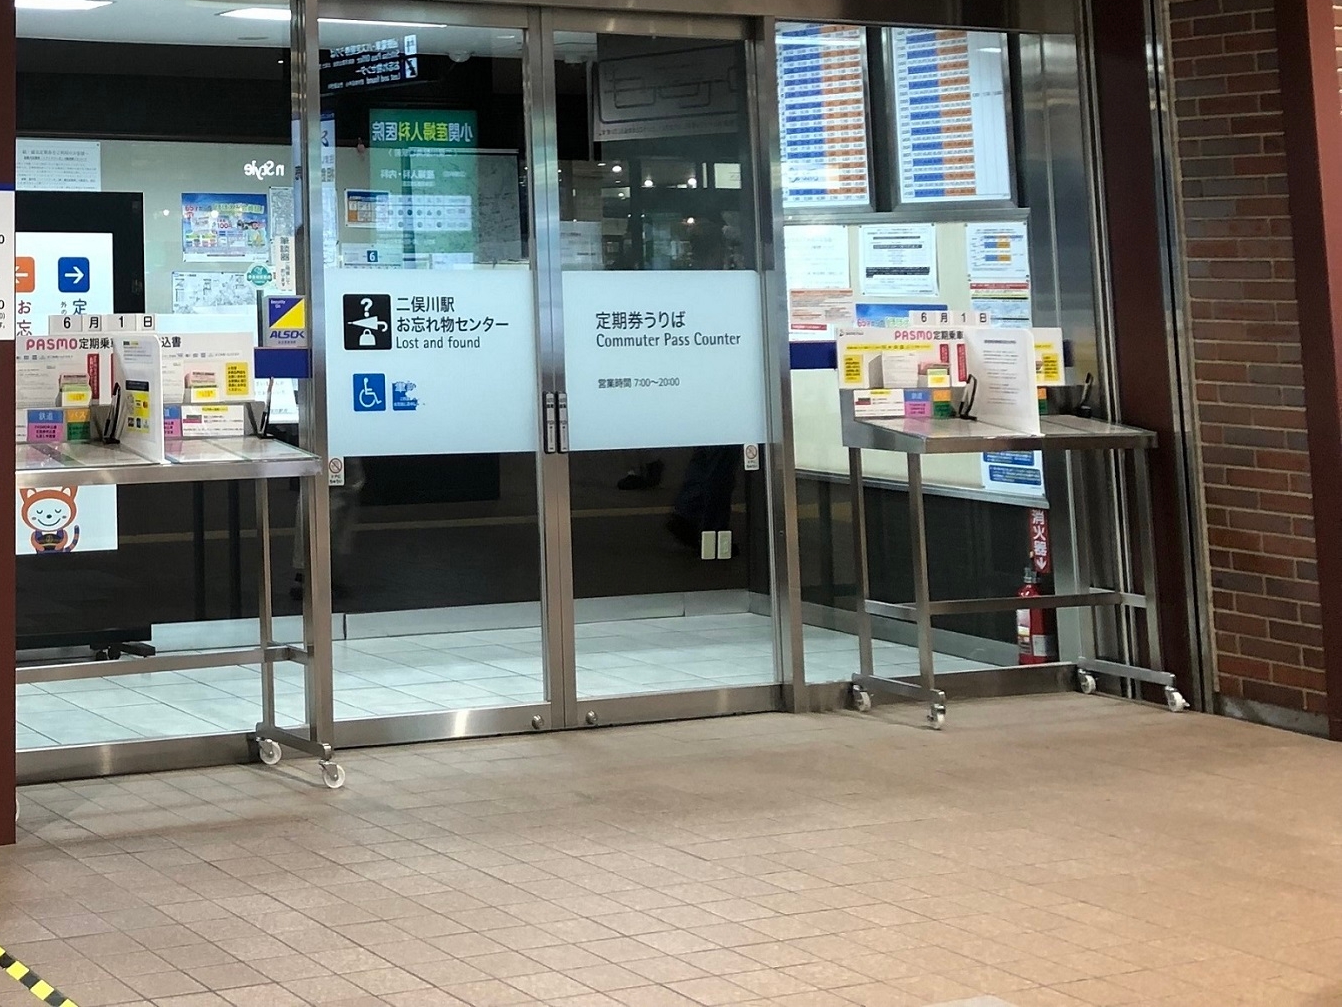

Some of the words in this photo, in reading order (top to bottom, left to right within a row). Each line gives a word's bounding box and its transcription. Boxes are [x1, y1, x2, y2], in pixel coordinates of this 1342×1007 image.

[396, 296, 455, 313] 二俣川駅
[63, 316, 71, 329] 6
[88, 316, 99, 329] 月
[118, 316, 124, 328] 1
[143, 316, 153, 328] 日
[396, 316, 509, 333] お忘れ物センター
[595, 311, 686, 330] 定期券うりば
[921, 312, 928, 323] 6
[940, 313, 948, 323] 月
[961, 313, 966, 323] 1
[979, 313, 987, 323] 日
[270, 330, 305, 339] ALSOK
[596, 333, 660, 348] Commuter
[664, 332, 690, 347] Pass
[693, 331, 741, 346] Counter
[396, 336, 420, 349] Lost
[423, 336, 444, 349] and
[447, 336, 481, 349] found
[598, 378, 632, 389] 営業時間
[1031, 509, 1047, 556] 消火器
